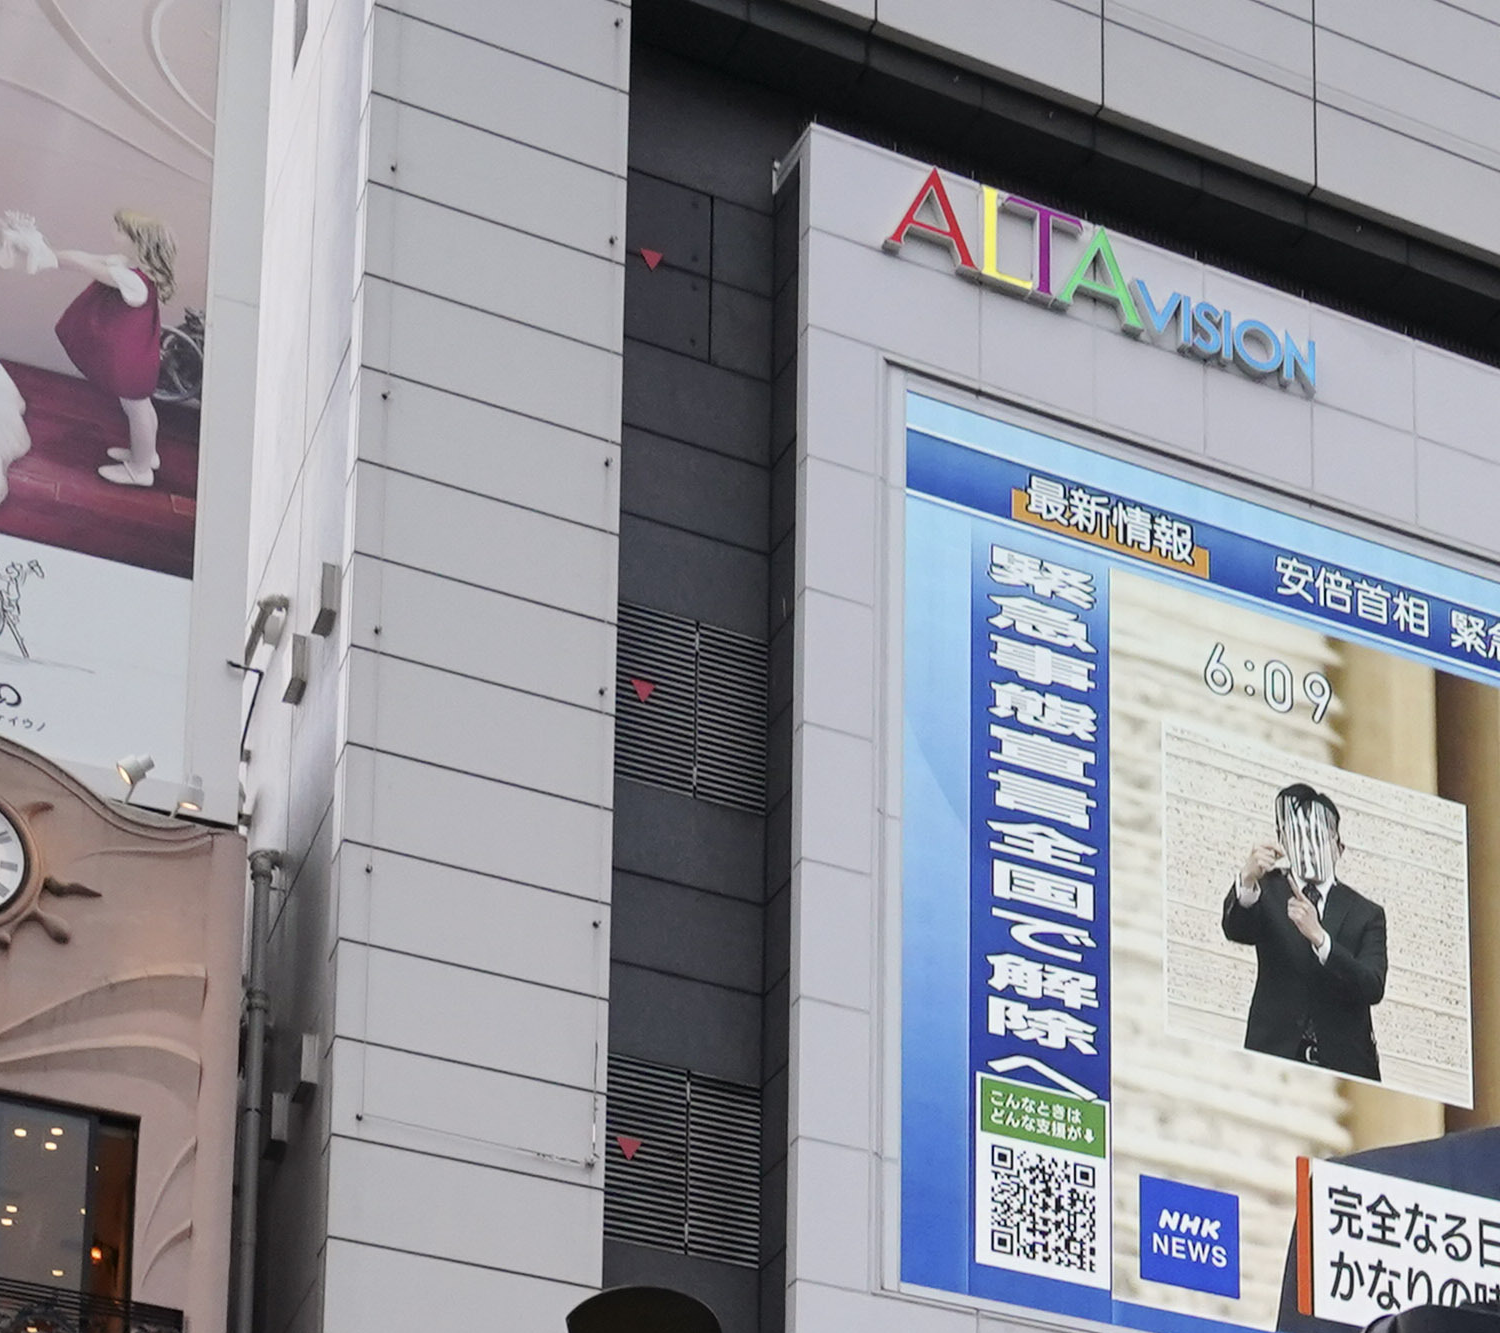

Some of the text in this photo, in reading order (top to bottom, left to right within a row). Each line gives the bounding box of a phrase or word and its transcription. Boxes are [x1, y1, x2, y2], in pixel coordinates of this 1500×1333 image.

[1130, 279, 1317, 398] VISION
[1027, 474, 1196, 565] 最新情報
[1275, 557, 1431, 638] 安倍首相
[1203, 643, 1333, 724] 6:09
[991, 1090, 1081, 1123] こんなときは
[1152, 1232, 1228, 1268] NEWS
[1158, 1209, 1221, 1241] NHK
